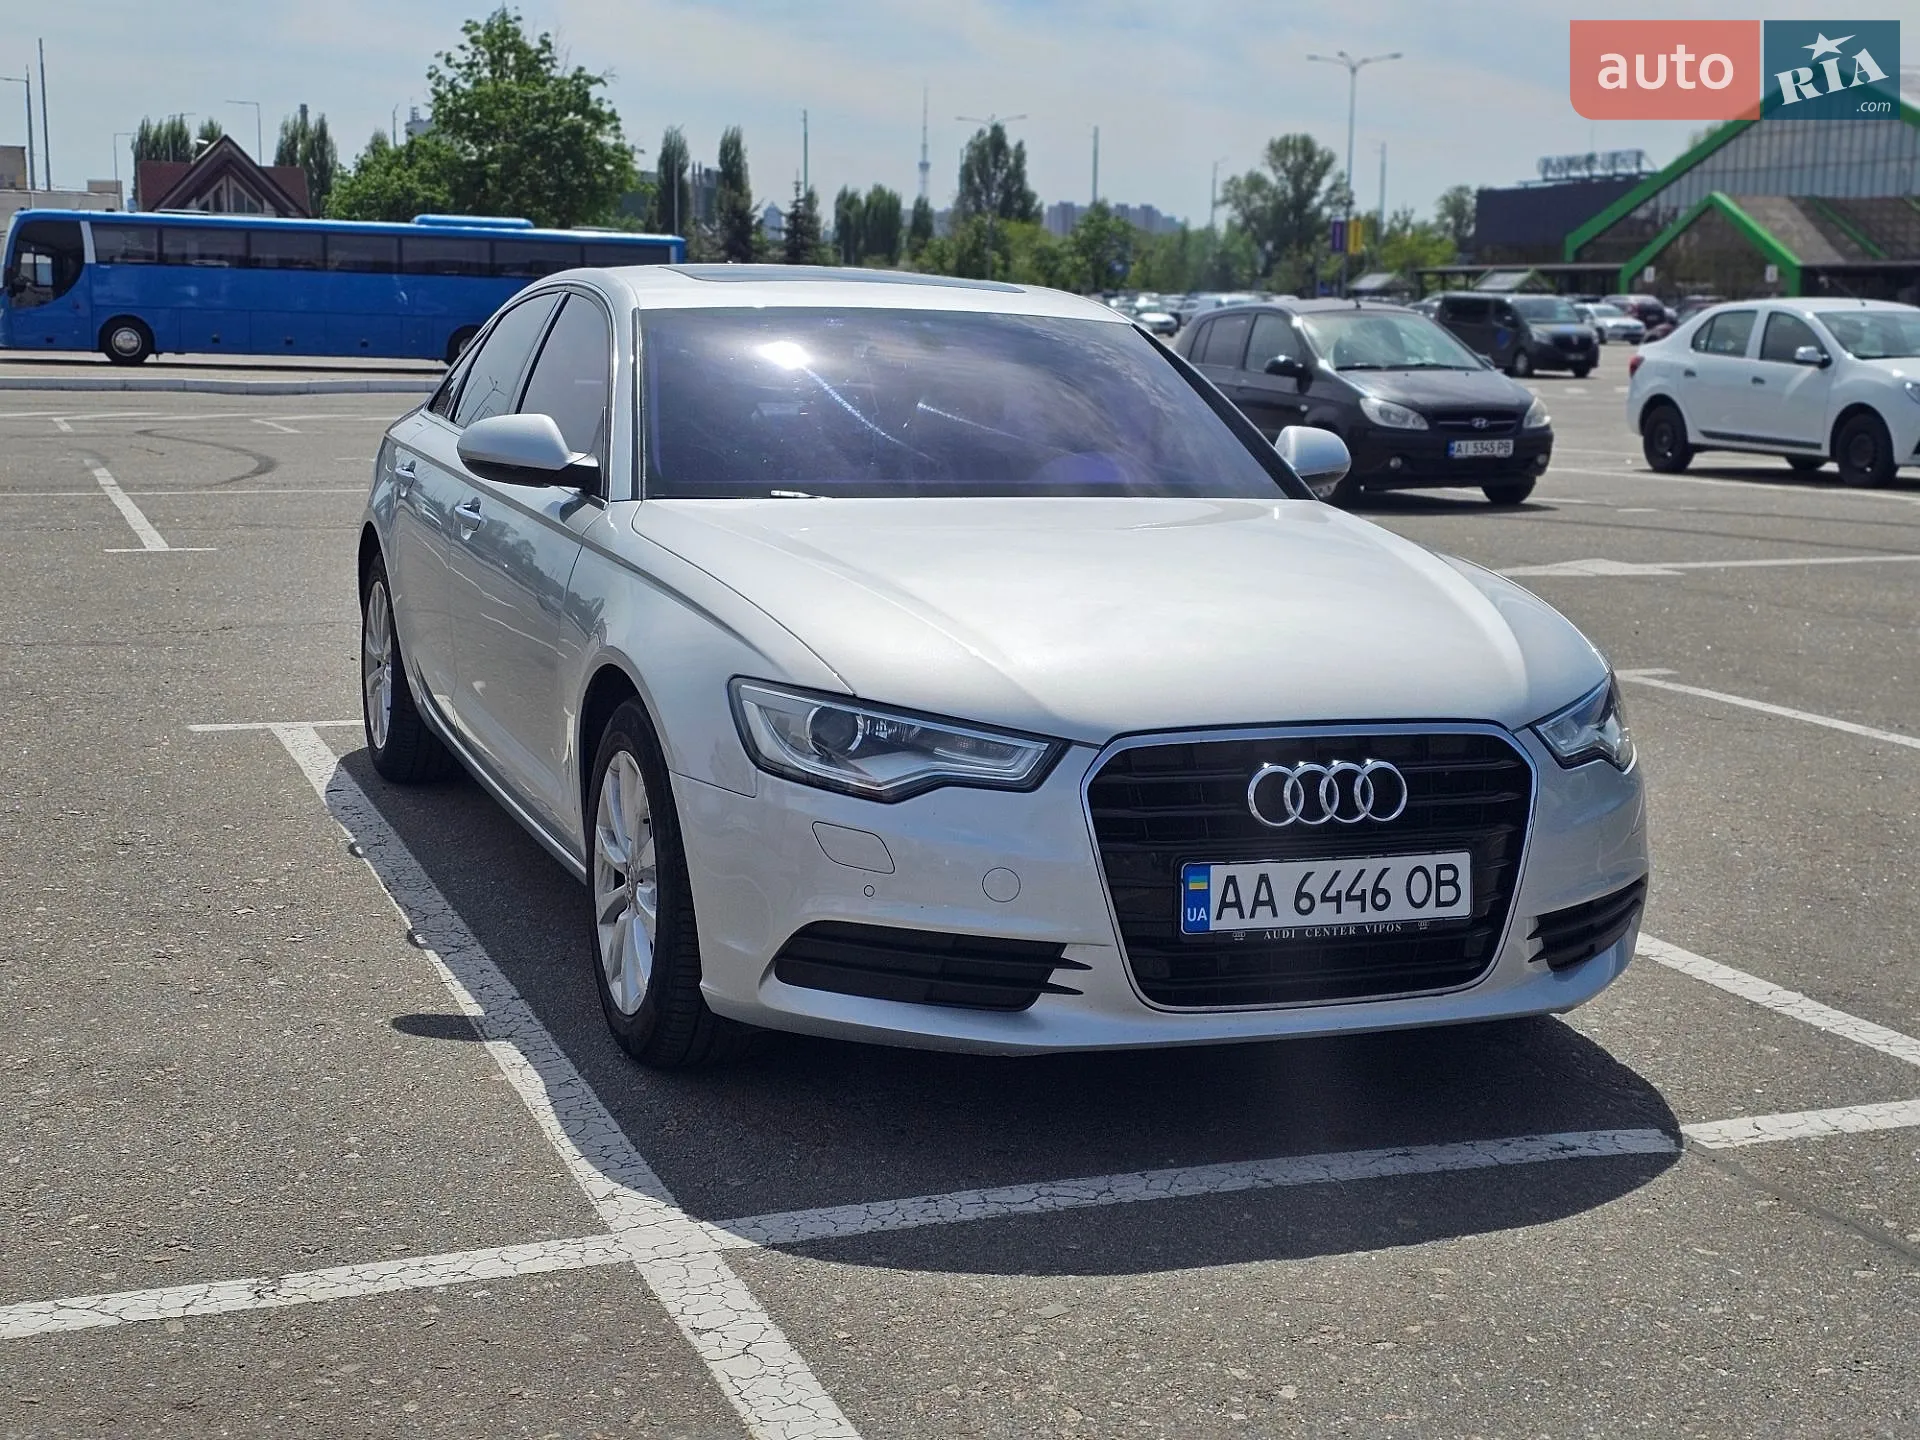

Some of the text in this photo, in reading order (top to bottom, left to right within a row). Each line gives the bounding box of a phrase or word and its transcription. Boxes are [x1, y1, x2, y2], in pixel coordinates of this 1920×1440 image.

[1456, 443, 1468, 454] AI
[1215, 863, 1462, 921] AA 6446 OB
[1187, 907, 1208, 922] UA
[1263, 923, 1402, 940] AUDI CENTER VIPOS
